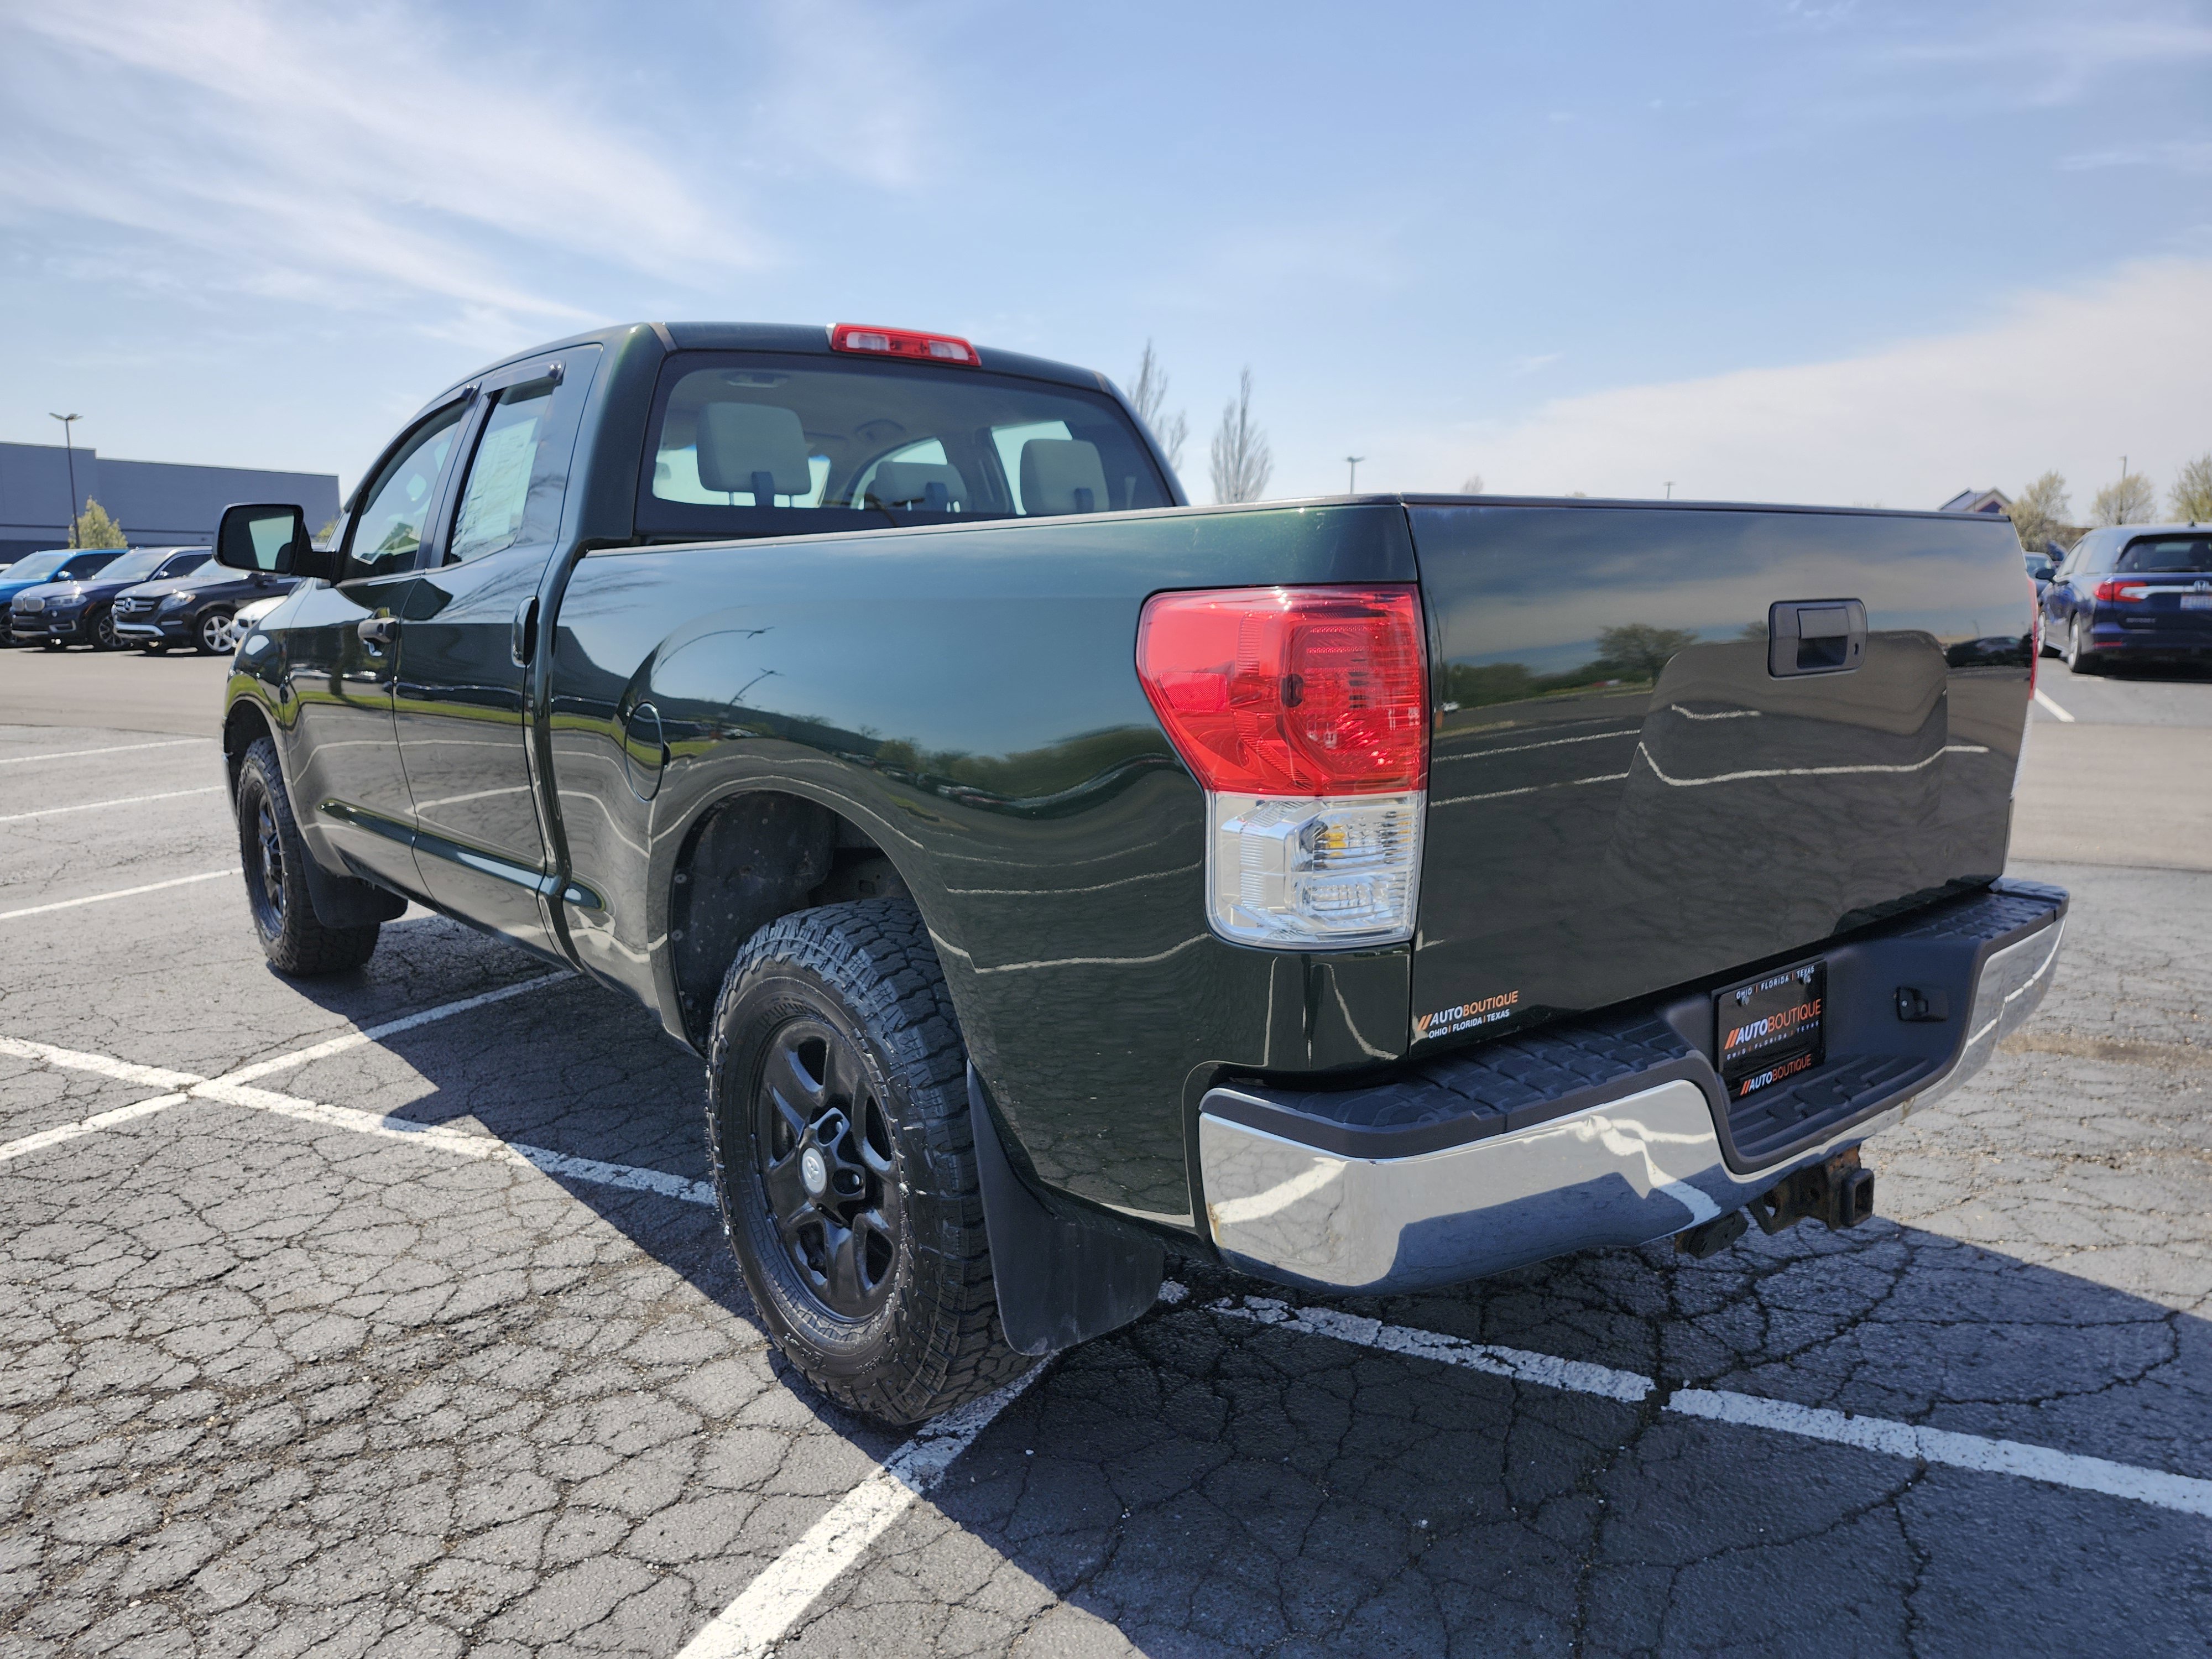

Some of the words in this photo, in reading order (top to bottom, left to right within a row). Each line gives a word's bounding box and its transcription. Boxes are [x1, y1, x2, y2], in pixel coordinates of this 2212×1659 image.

[1736, 987, 1752, 1000] OHIO
[1761, 975, 1789, 992] FLORIDA
[1428, 1027, 1448, 1039] OHIO
[1452, 1017, 1483, 1032] FLORIDA
[1486, 1009, 1510, 1022] TEXAS
[1430, 990, 1519, 1027] AUTOBOUTIQUE
[1735, 998, 1822, 1046] AUTOBOUTIQUE
[1748, 1053, 1812, 1093] AUTOBOUTIQUE
